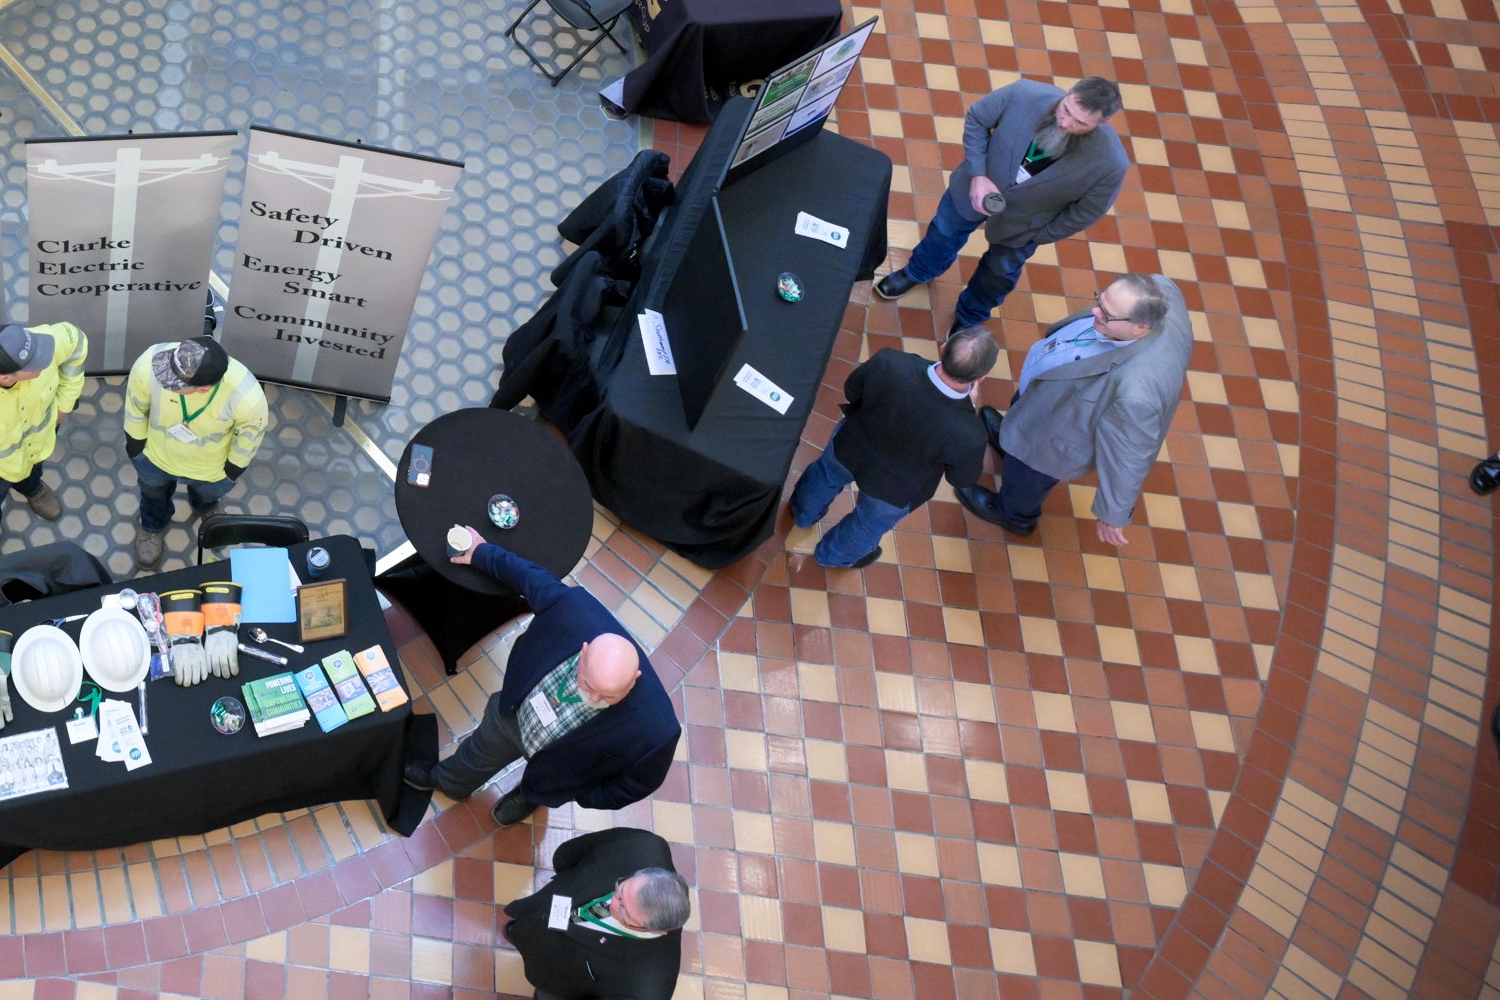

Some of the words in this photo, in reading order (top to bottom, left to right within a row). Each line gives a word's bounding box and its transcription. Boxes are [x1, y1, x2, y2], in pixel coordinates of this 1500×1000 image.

[249, 200, 340, 230] Safety
[37, 237, 131, 254] Clarke
[292, 229, 393, 262] Driven
[37, 259, 145, 276] Electric
[241, 252, 343, 285] Energy
[37, 280, 201, 297] Cooperative
[283, 281, 368, 308] Smart
[234, 305, 396, 346] Community
[273, 328, 386, 360] Invested
[281, 683, 297, 694] LIVES
